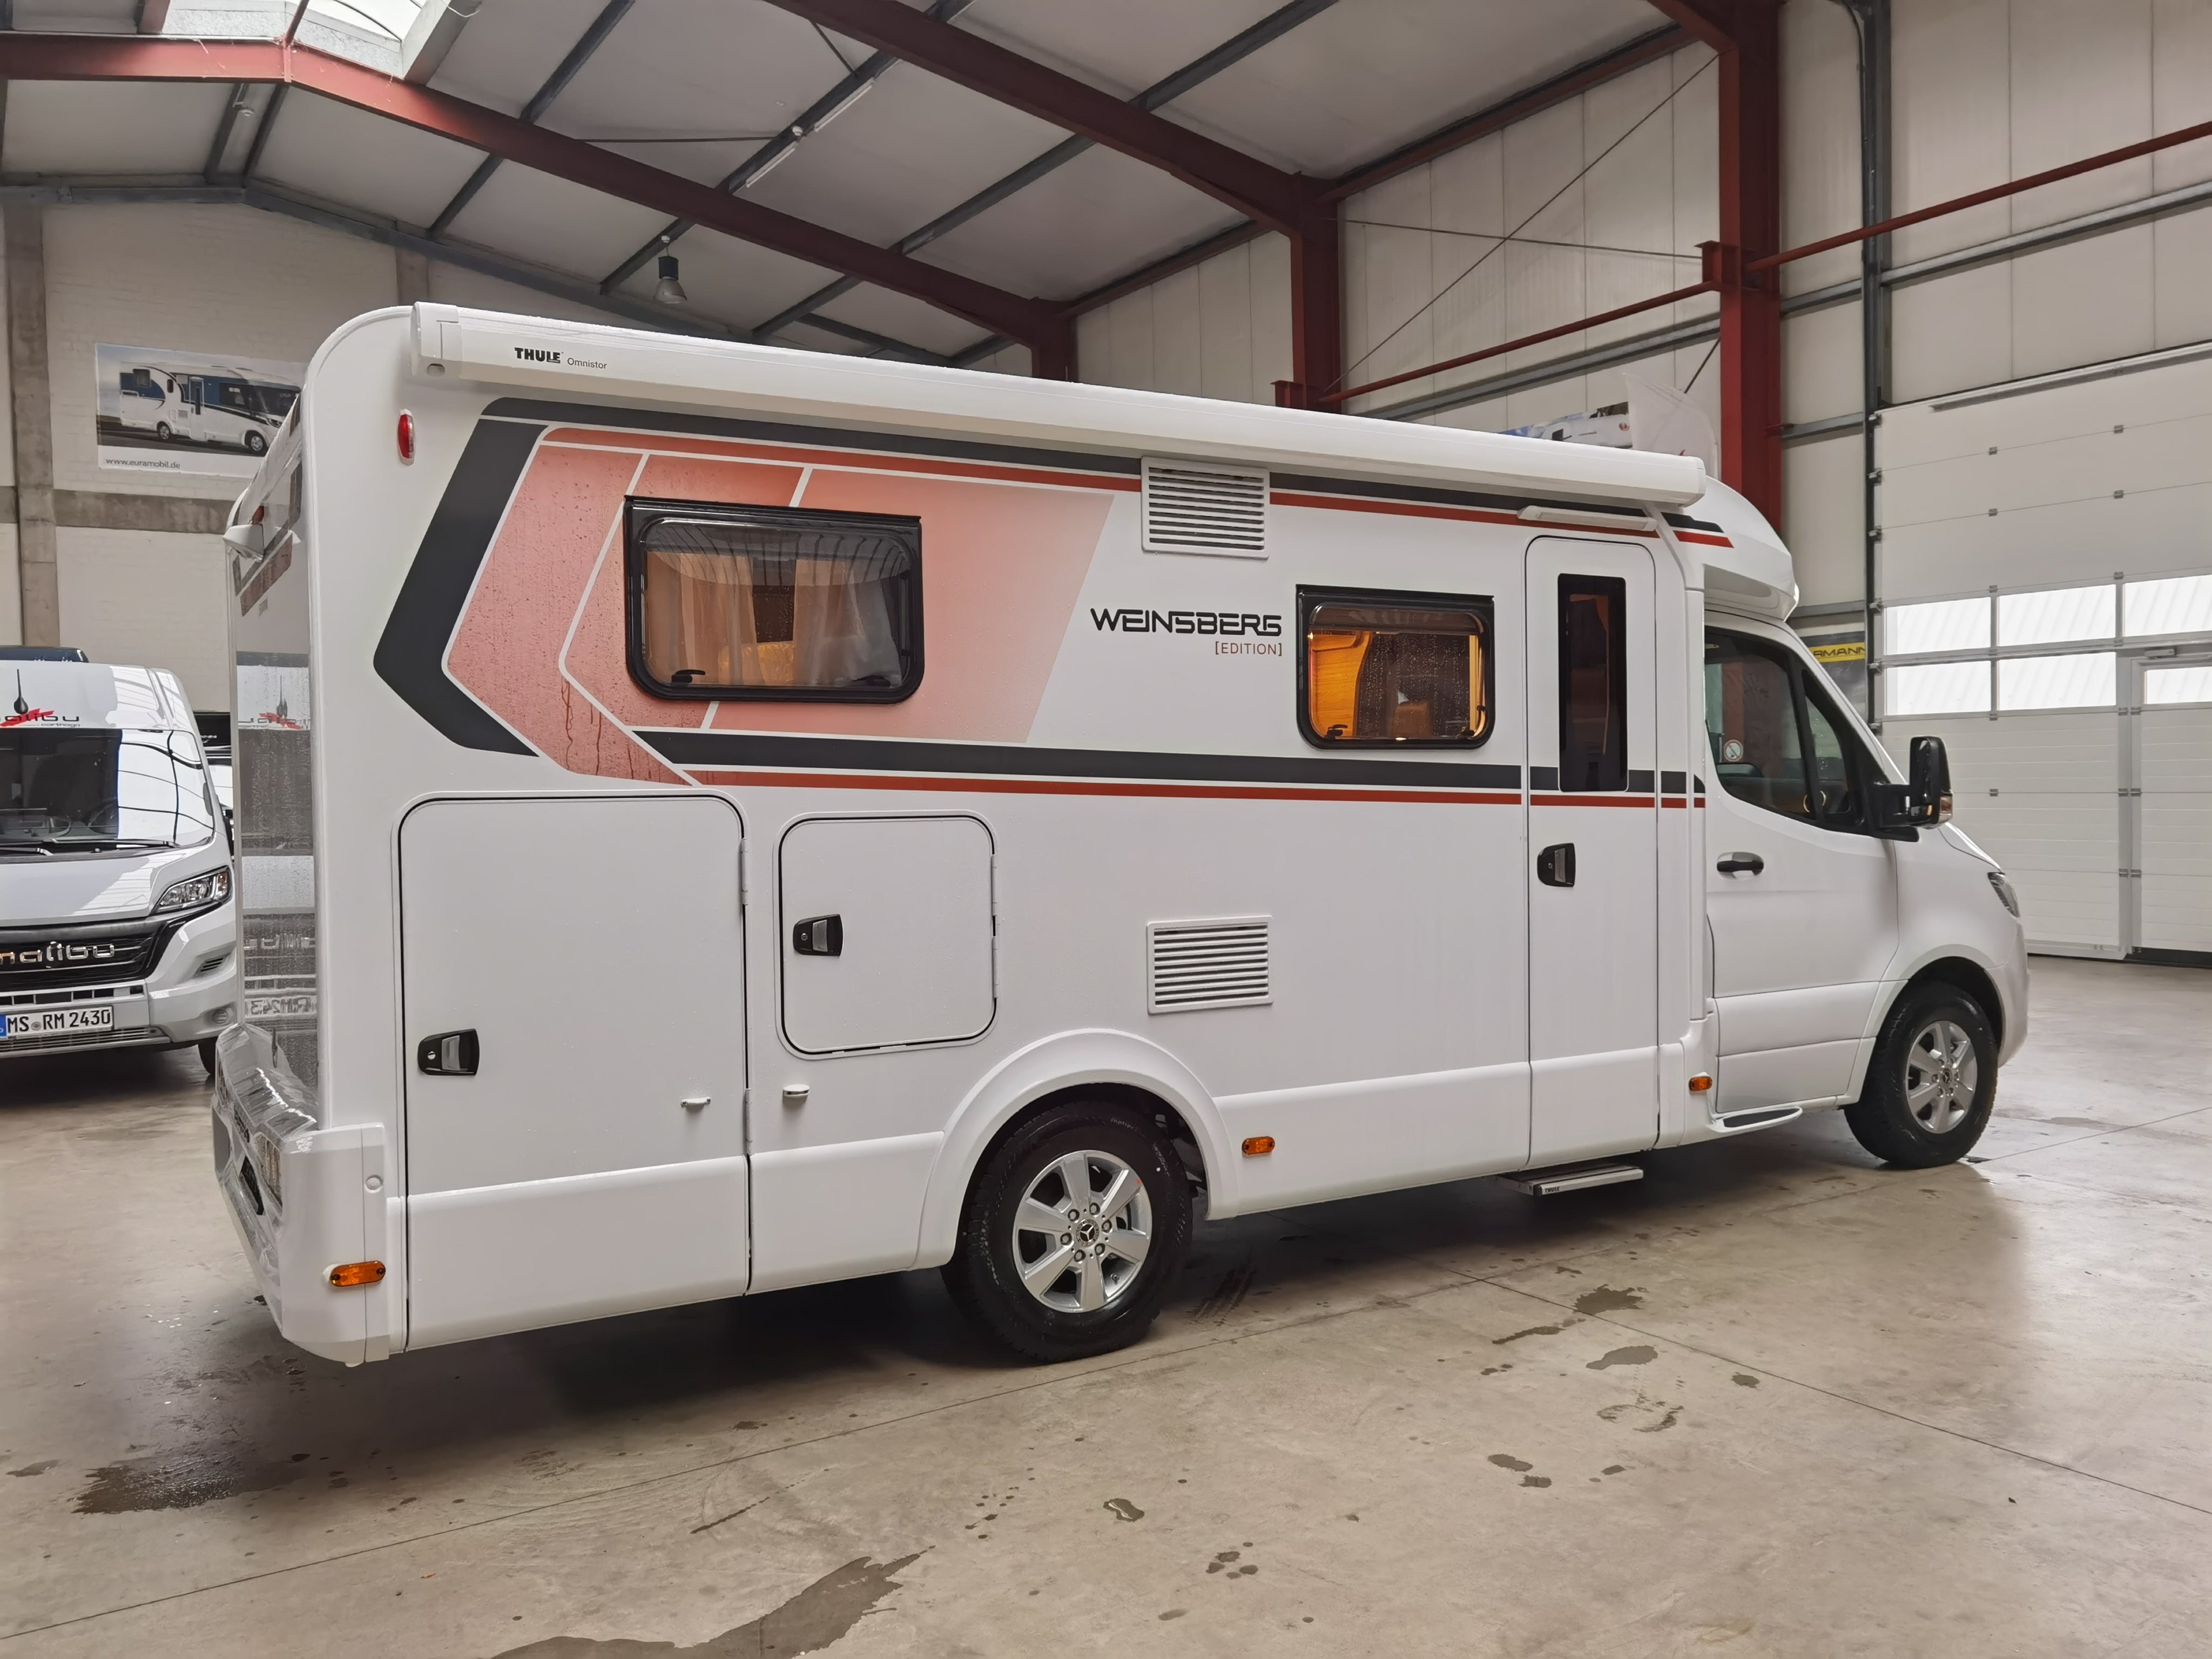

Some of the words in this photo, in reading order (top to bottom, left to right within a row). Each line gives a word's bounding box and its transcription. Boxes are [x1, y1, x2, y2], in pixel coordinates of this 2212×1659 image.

[514, 347, 561, 364] THULE
[567, 357, 608, 369] Omnistor
[105, 458, 180, 469] www.euramobil.de
[1090, 608, 1282, 636] WEINSBERG
[0, 713, 79, 722] alibu
[7, 1016, 29, 1033] MS
[43, 1013, 65, 1030] RM
[69, 1009, 111, 1028] 2430
